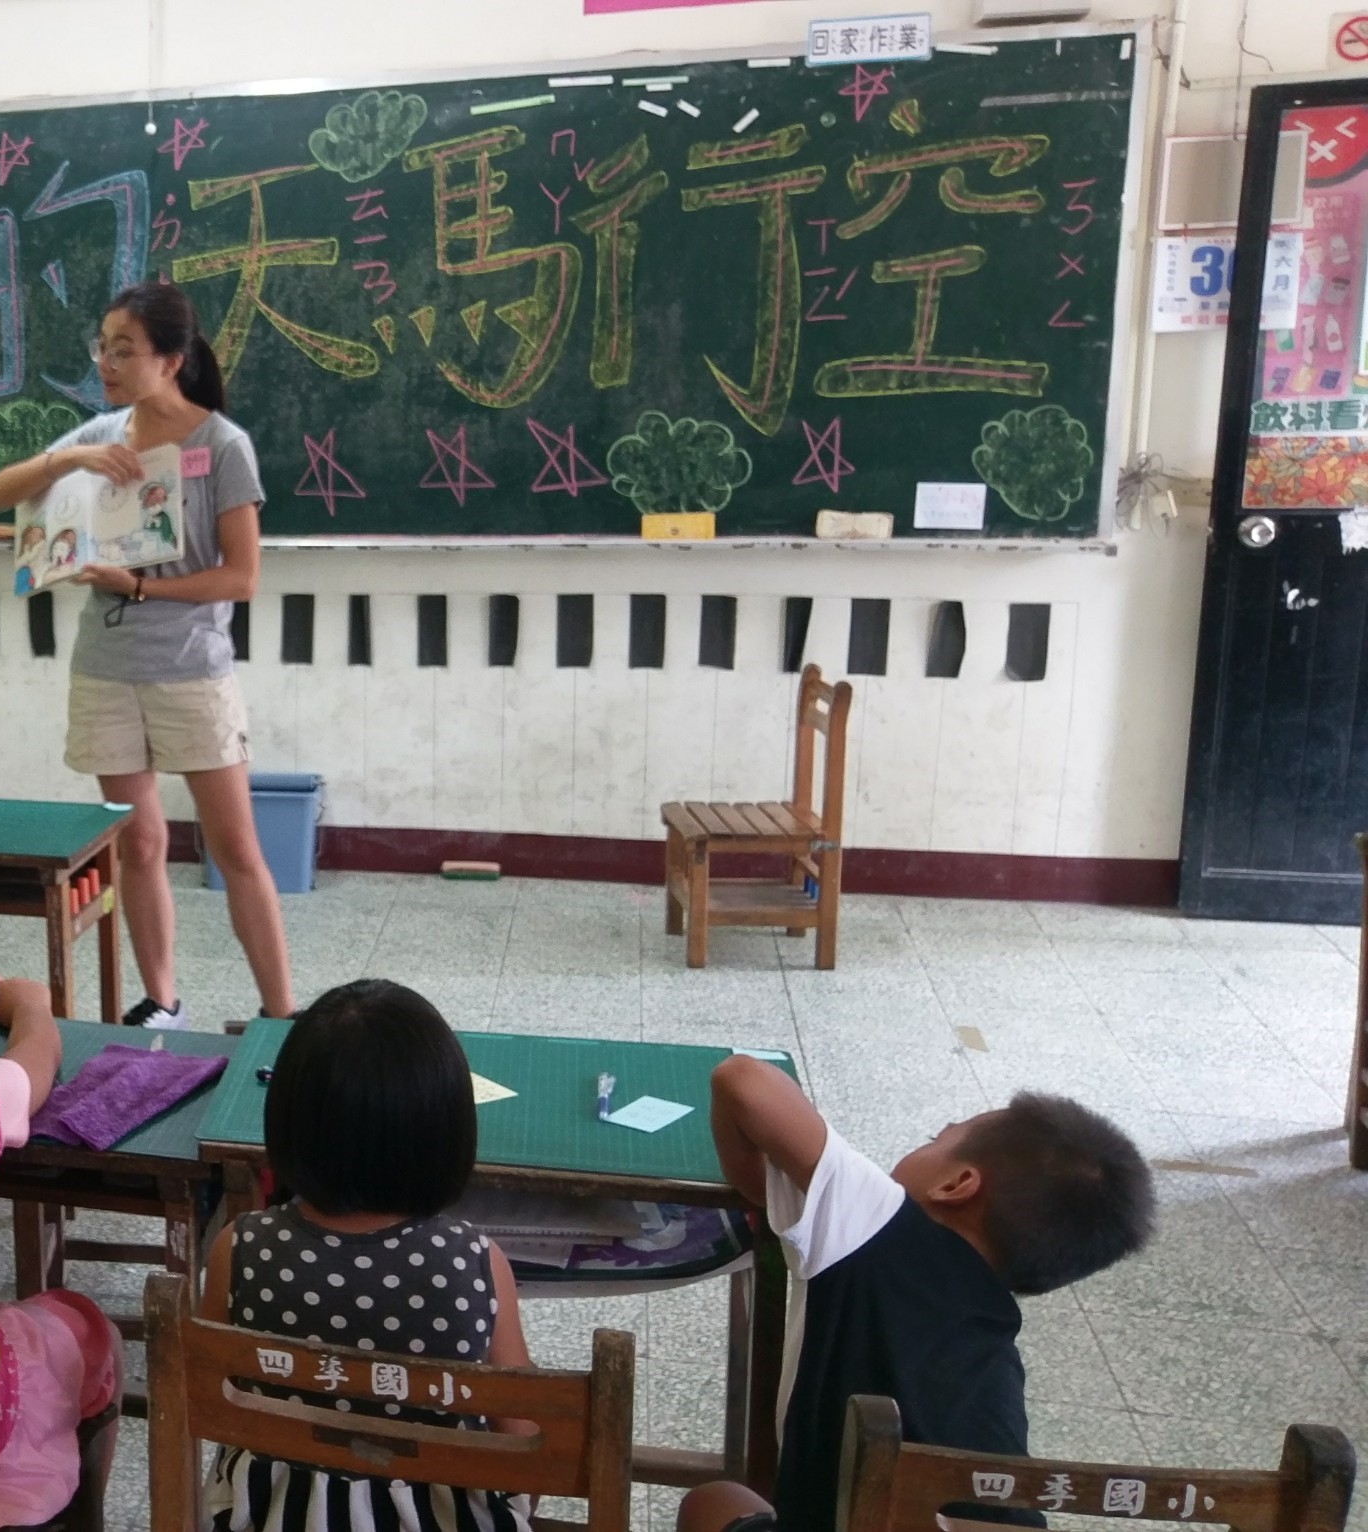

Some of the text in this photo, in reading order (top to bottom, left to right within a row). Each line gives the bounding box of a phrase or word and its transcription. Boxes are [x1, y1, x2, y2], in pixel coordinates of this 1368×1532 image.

[812, 24, 919, 57] 回家作業
[1190, 246, 1236, 296] 3
[1251, 401, 1368, 431] 飲料看
[258, 1348, 472, 1406] 四季國小
[972, 1471, 1215, 1519] 四季國小
